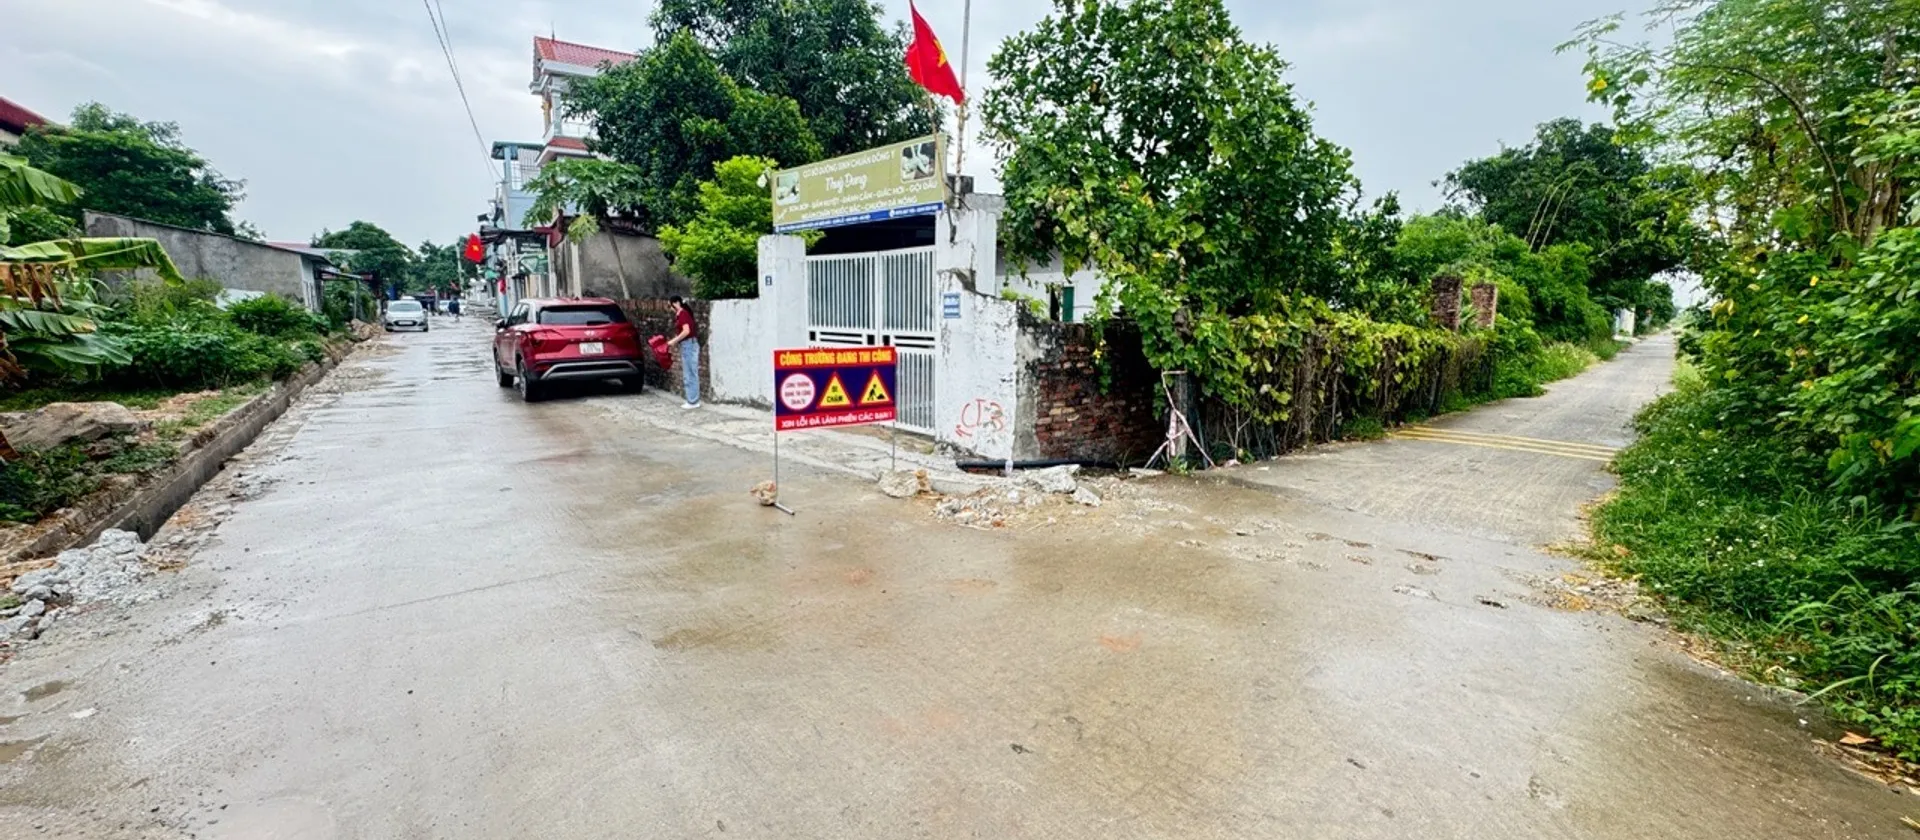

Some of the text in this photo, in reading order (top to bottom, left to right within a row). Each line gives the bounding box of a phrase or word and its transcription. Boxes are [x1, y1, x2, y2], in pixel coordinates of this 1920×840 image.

[780, 348, 892, 366] CÔNG TRƯỜNG ĐANG THI CÔNG
[781, 420, 795, 428] XIN
[797, 415, 808, 427] LỖI
[809, 415, 820, 426] ĐÃ
[821, 414, 837, 424] LÀM
[838, 412, 858, 423] PHIỀN
[859, 411, 873, 422] CÁC
